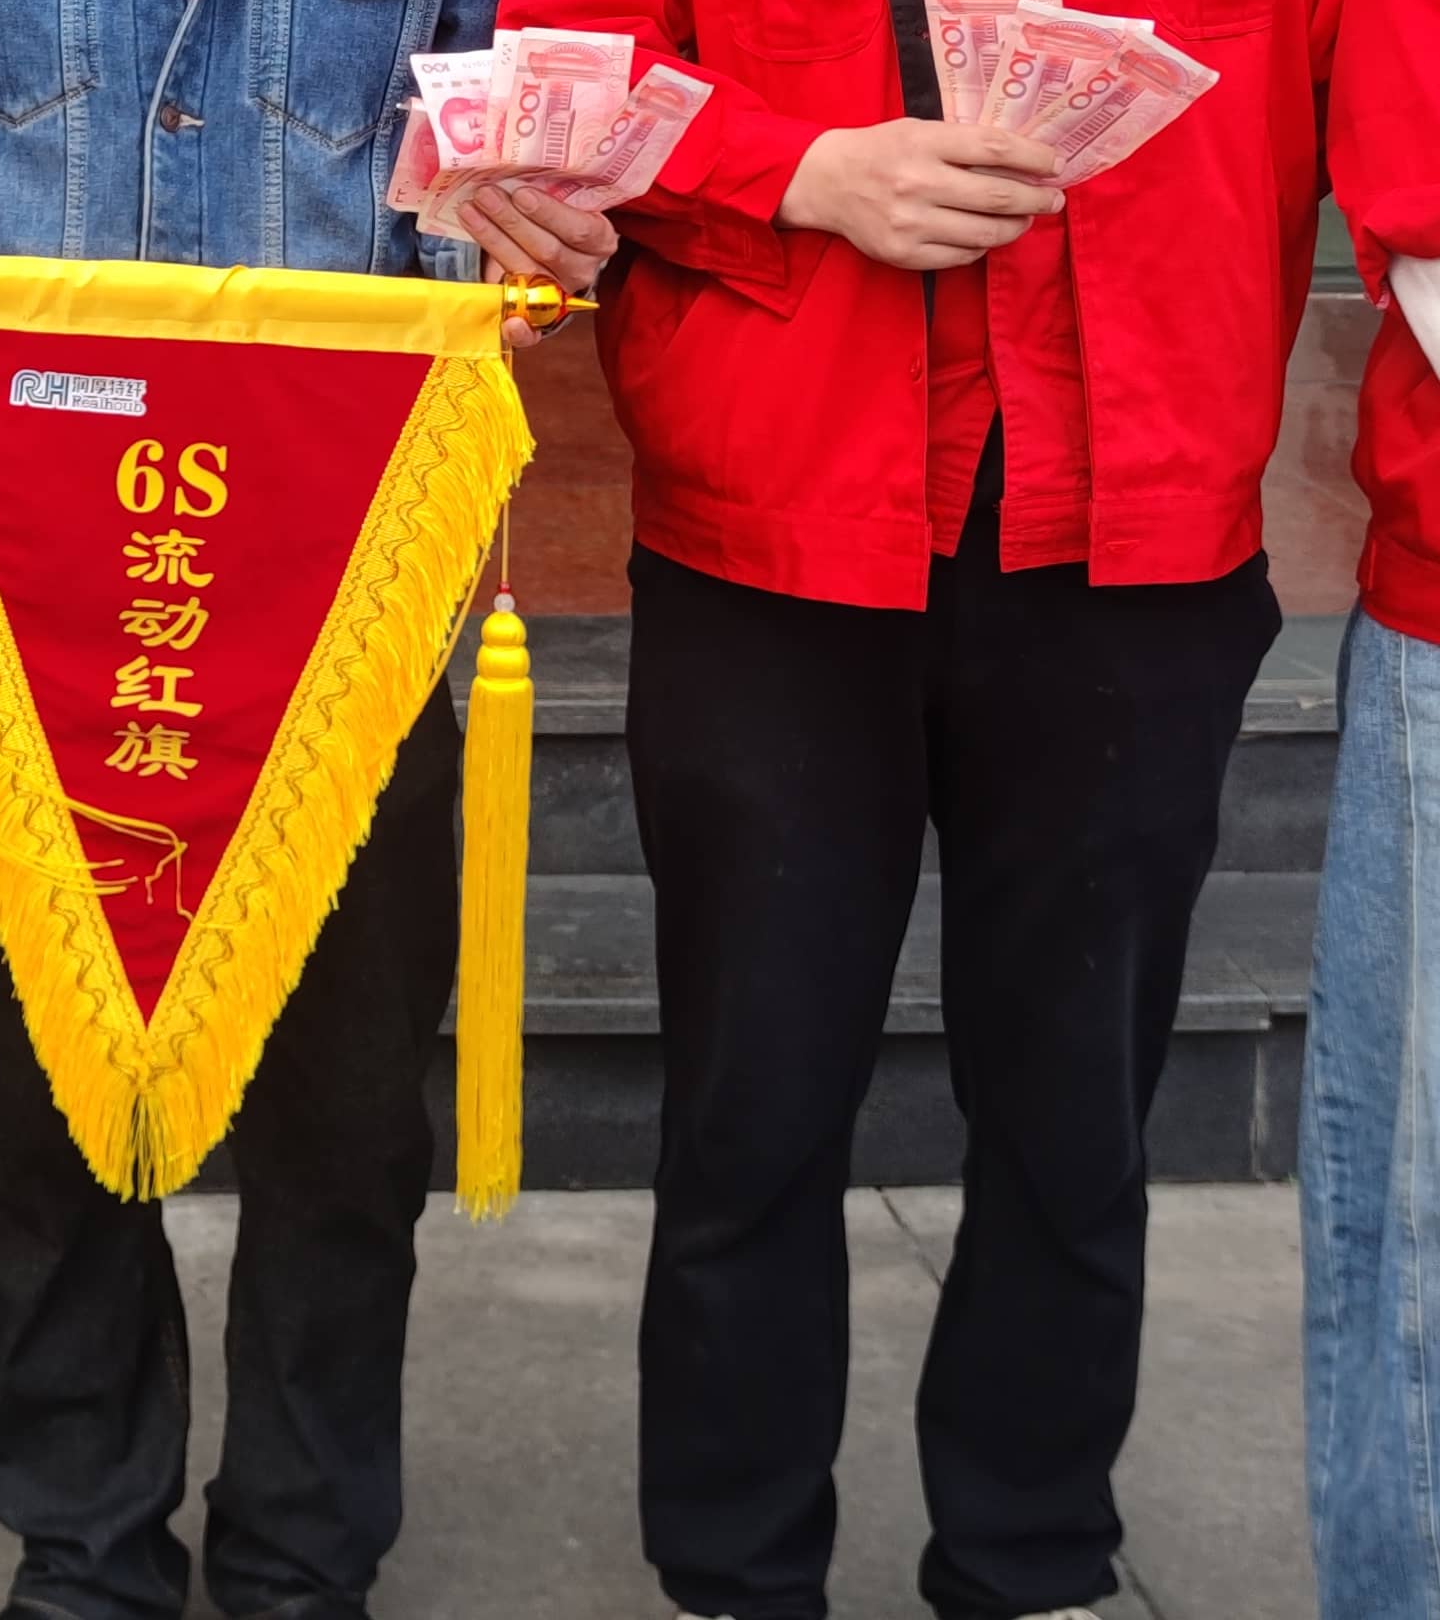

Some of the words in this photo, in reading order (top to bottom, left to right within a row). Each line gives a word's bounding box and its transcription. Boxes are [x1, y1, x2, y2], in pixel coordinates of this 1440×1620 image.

[939, 15, 967, 69] 100
[1002, 49, 1038, 99] 100
[1069, 68, 1119, 110] 100
[516, 80, 541, 138] 100
[596, 109, 636, 157] 100
[13, 371, 70, 407] RH
[116, 439, 228, 518] 6S
[104, 528, 215, 780] 流动红旗
